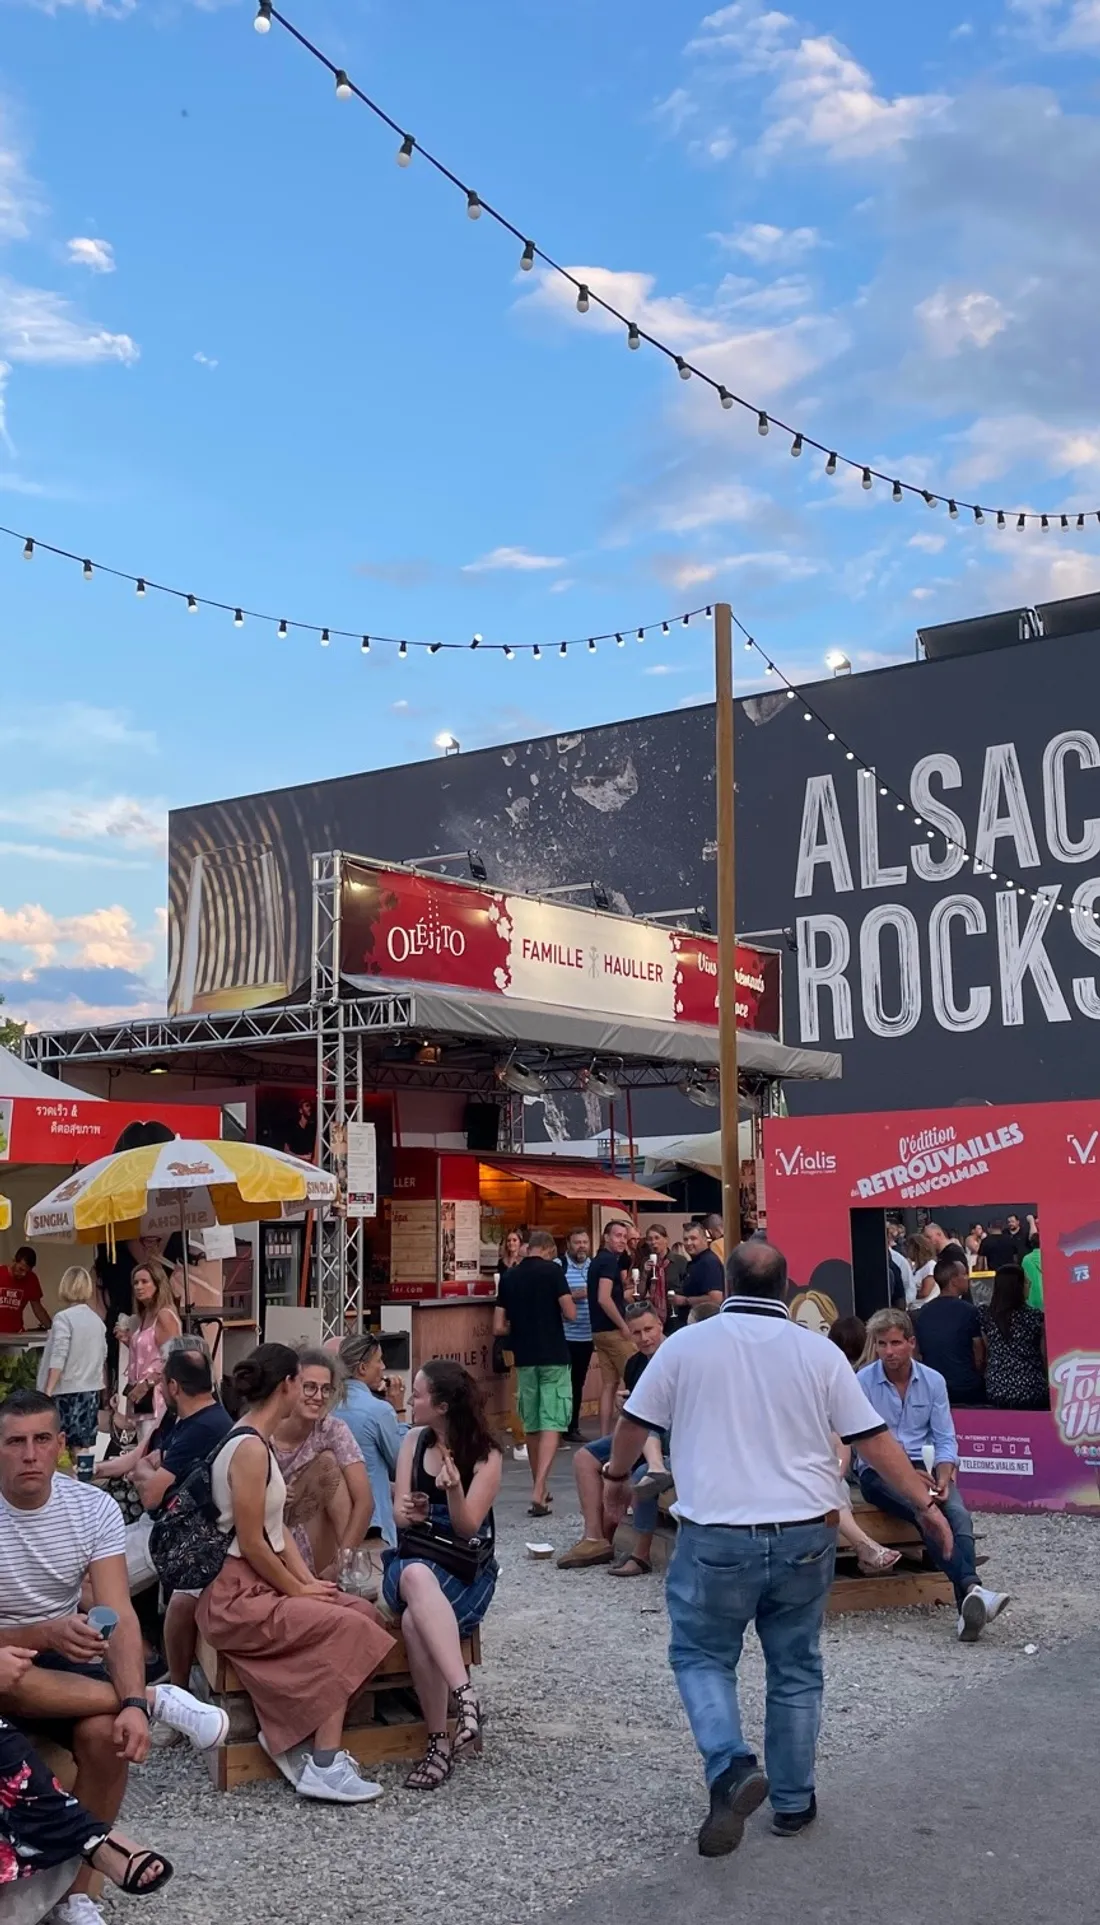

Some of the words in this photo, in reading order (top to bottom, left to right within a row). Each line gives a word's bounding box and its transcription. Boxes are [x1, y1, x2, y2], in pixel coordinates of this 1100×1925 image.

[522, 939, 584, 969] FAMILLE
[604, 960, 664, 983] HAULLER
[698, 952, 717, 976] Vins
[796, 877, 1100, 1043] ROCKS
[779, 1145, 837, 1176] Vialis
[857, 1122, 1025, 1199] RETROUVAILLES
[899, 1126, 957, 1163] l'édition
[33, 1212, 69, 1229] SINGHA
